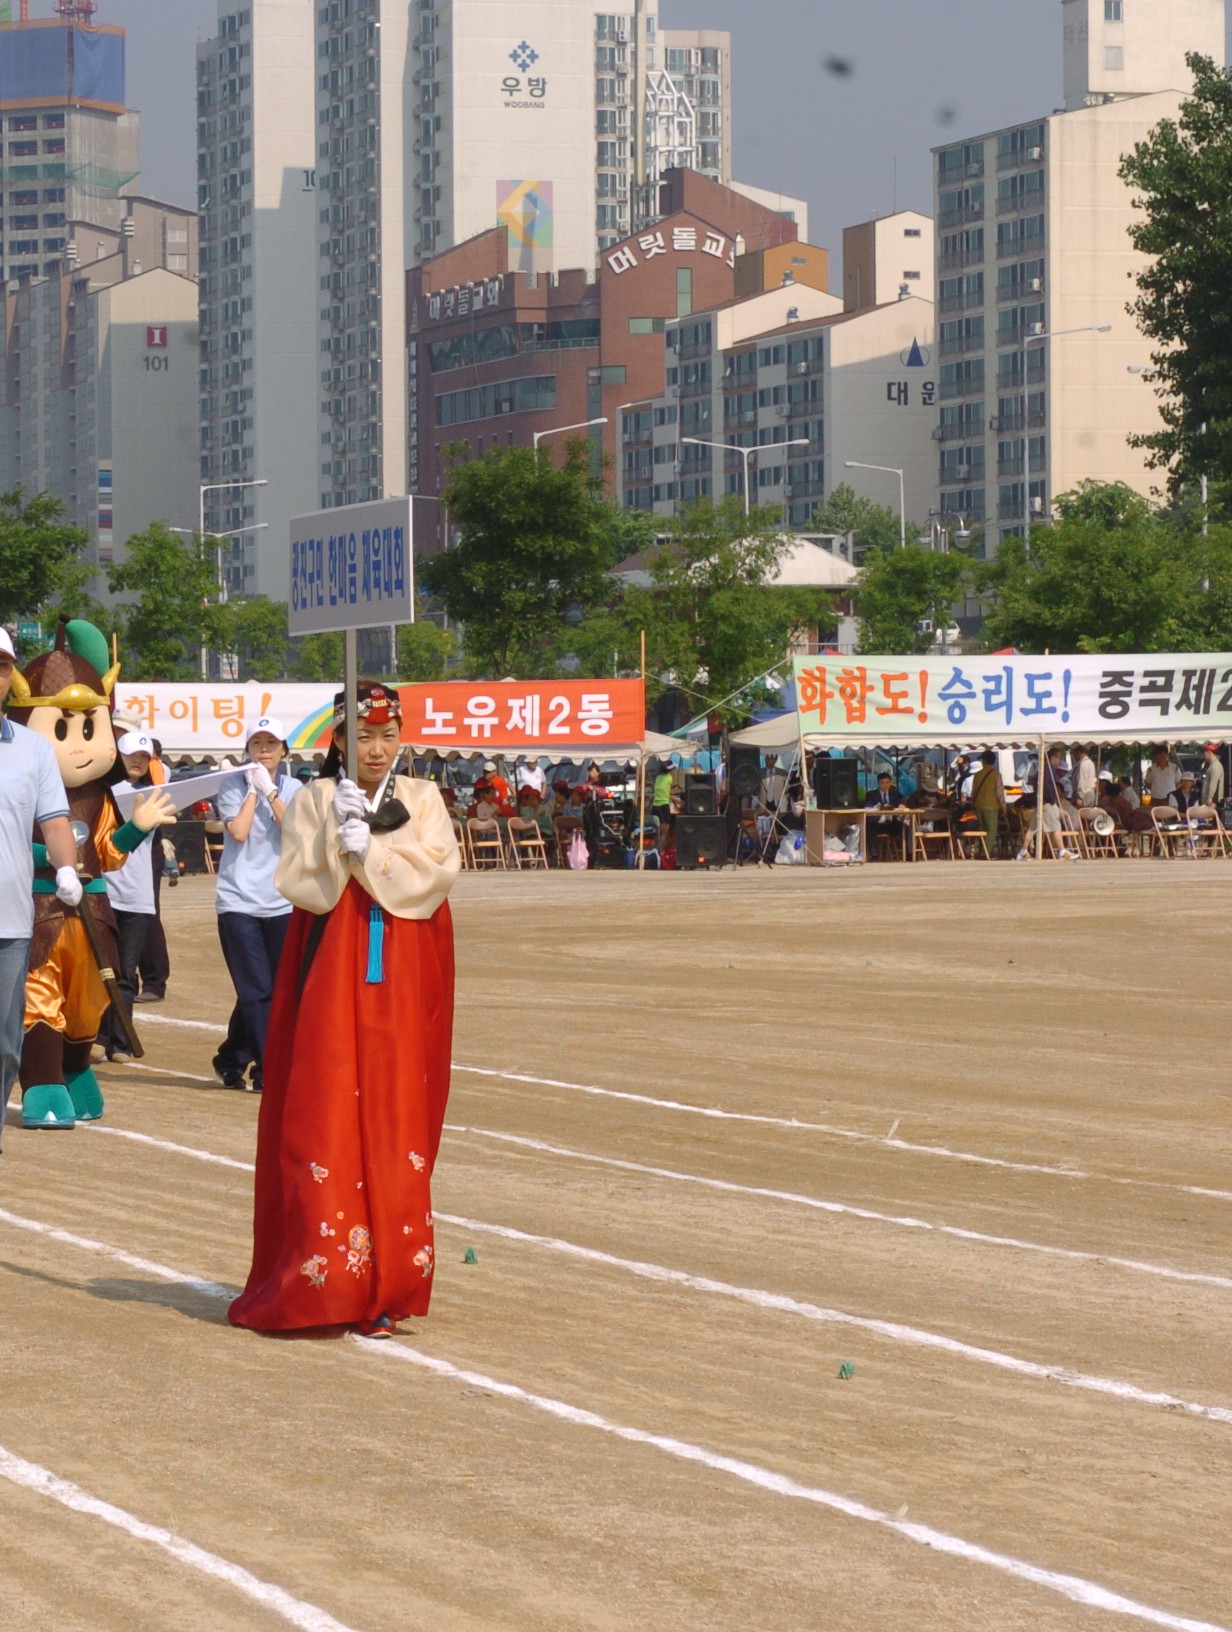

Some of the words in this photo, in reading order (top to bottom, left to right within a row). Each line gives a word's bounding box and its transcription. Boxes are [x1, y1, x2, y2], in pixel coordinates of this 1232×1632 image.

[501, 76, 547, 98] 우방
[607, 227, 735, 275] 머릿돌교
[144, 355, 169, 371] 101
[292, 538, 324, 612] 광진구민
[328, 532, 357, 604] 한마음
[362, 525, 405, 602] 체육대회
[421, 693, 614, 738] 노유제2동
[797, 665, 929, 725] 화합도!
[937, 665, 1072, 726] 승리도!
